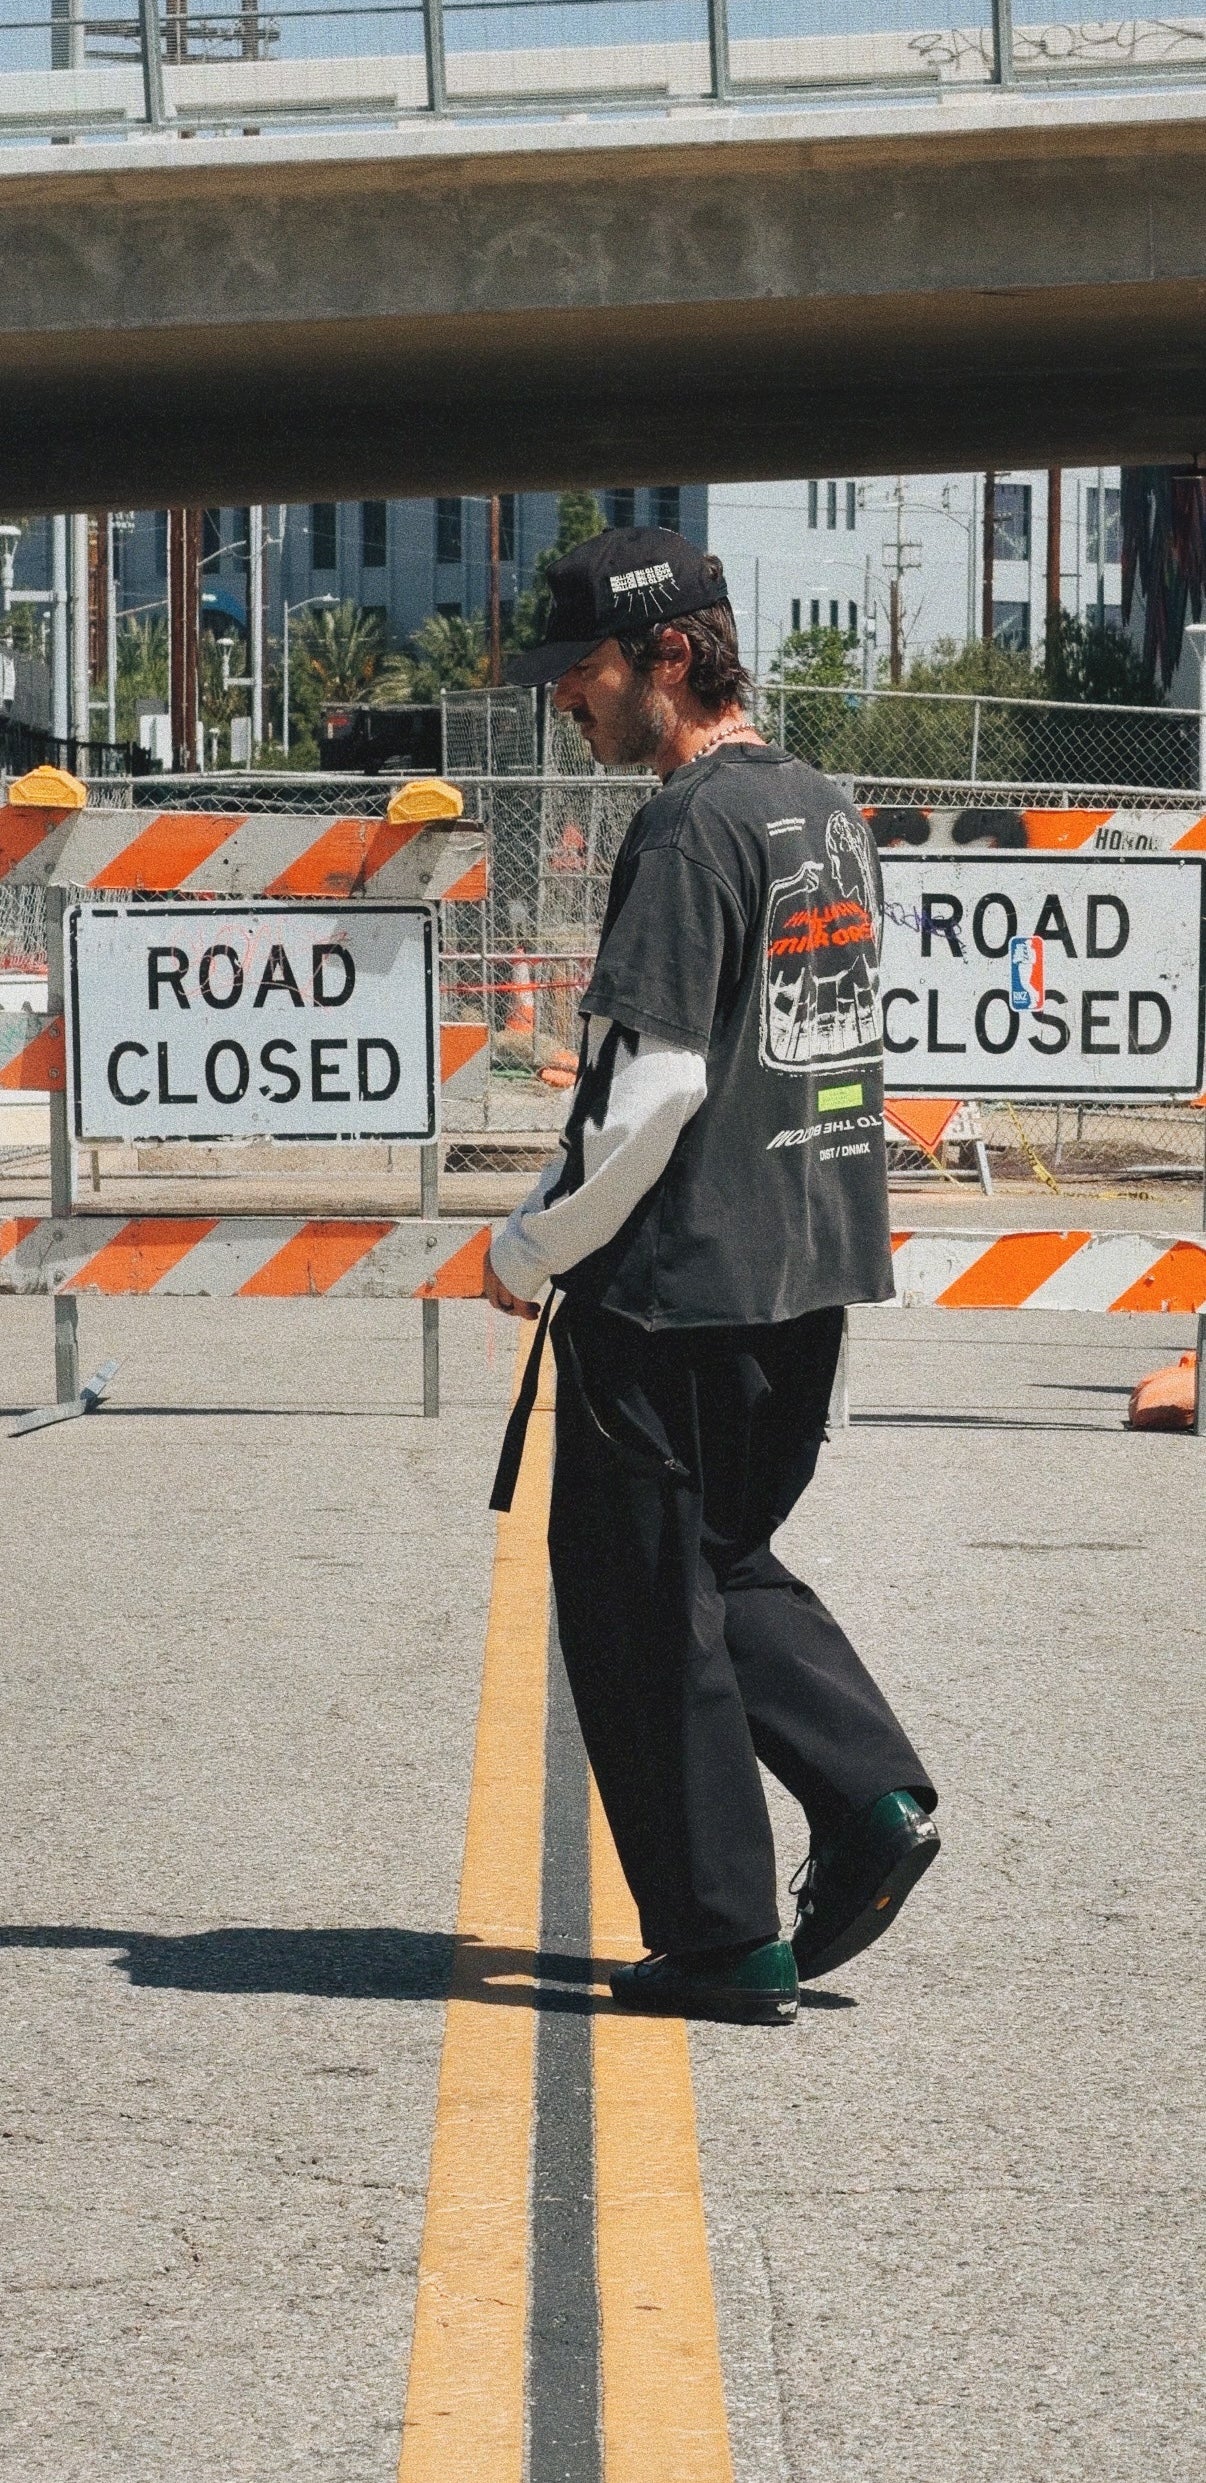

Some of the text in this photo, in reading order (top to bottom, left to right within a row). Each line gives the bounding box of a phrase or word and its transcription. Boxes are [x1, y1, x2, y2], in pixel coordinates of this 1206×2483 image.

[921, 893, 1132, 960] ROAD
[147, 943, 357, 1010] ROAD
[881, 988, 1172, 1057] CLOSED
[107, 1036, 402, 1107] CLOSED
[822, 1119, 855, 1133] THE
[856, 1114, 882, 1128] TO
